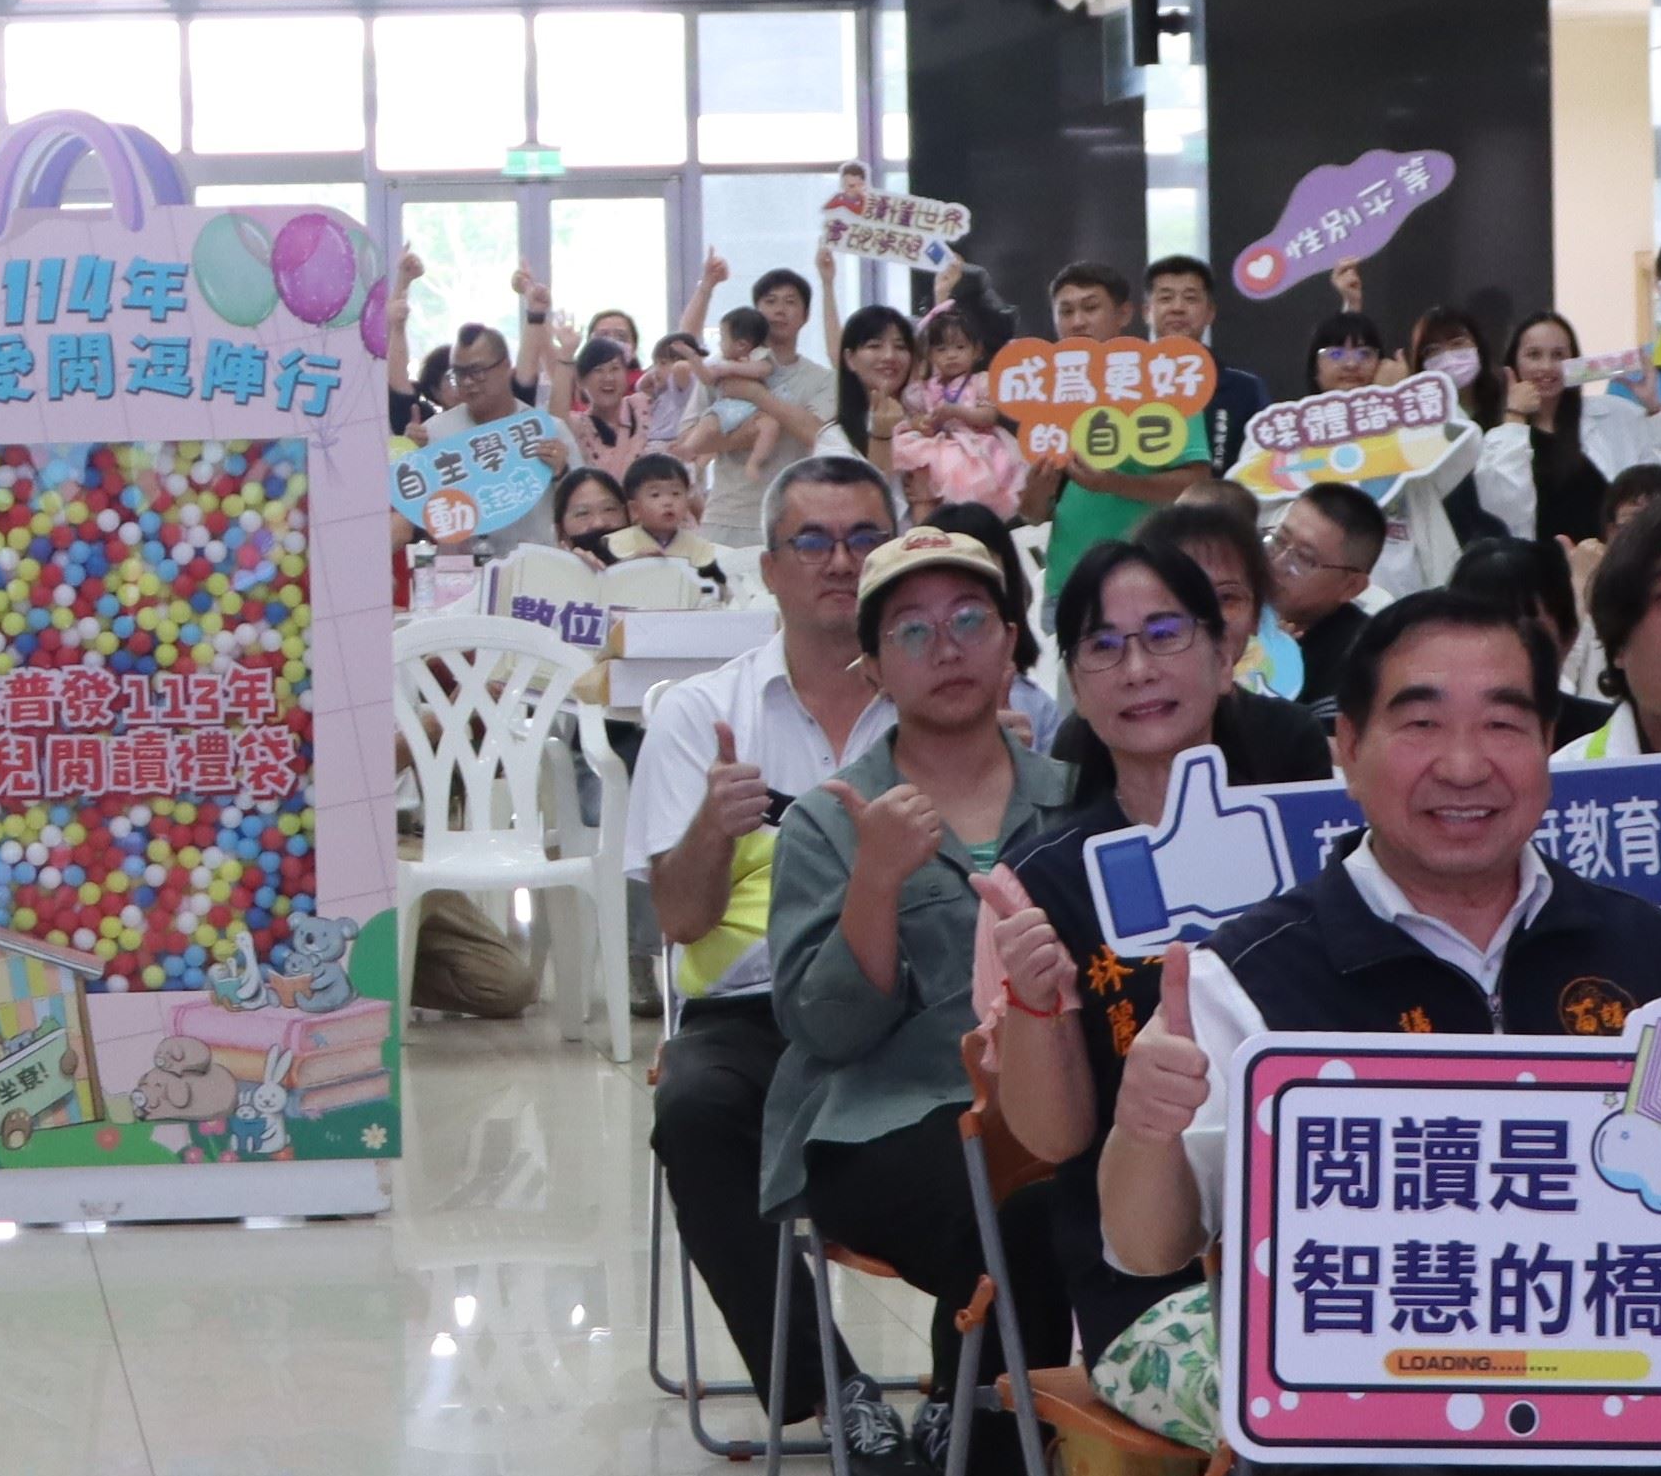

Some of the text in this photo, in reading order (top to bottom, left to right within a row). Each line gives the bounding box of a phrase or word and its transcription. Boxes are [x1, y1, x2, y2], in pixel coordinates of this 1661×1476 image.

[1285, 157, 1433, 261] 性別平等
[1, 254, 189, 325] 114年
[1257, 377, 1448, 452] 媒體識讀
[396, 418, 544, 498] 自主學習
[1295, 1115, 1579, 1213] 閱讀是
